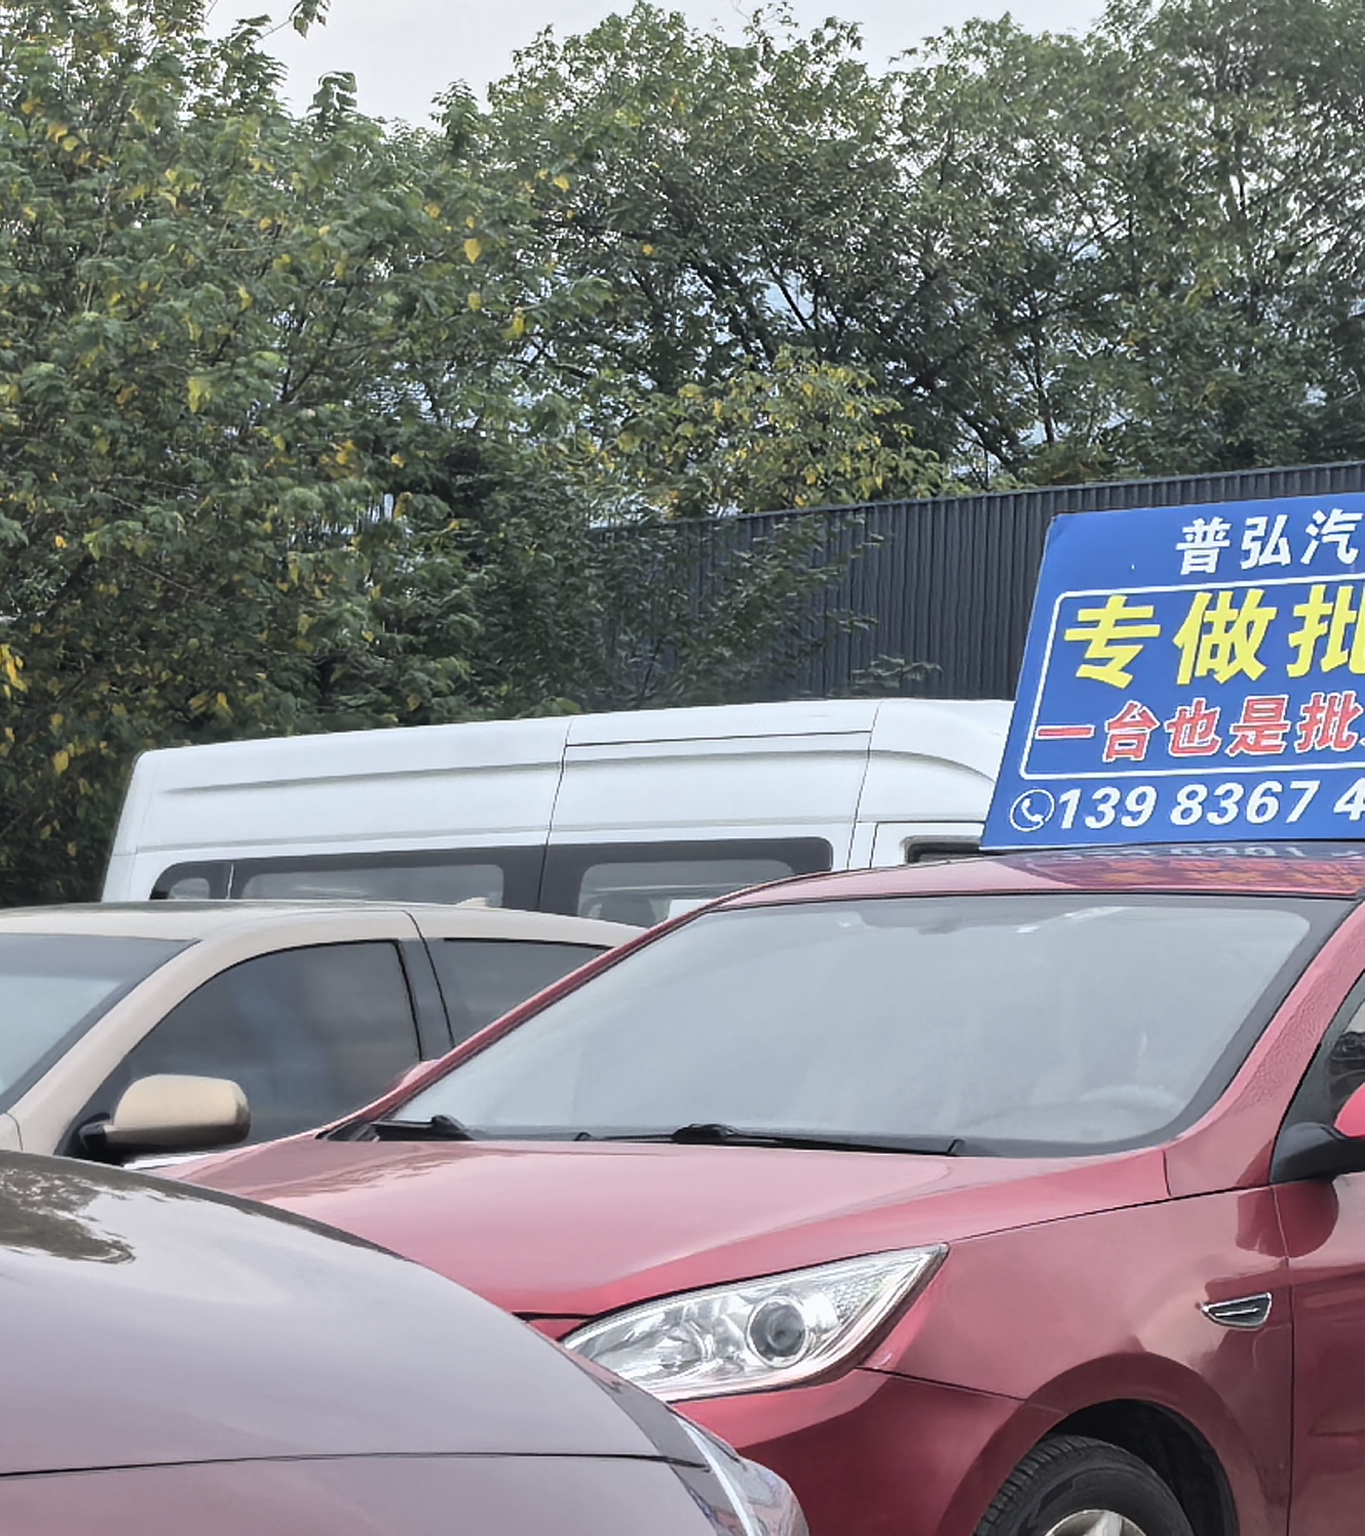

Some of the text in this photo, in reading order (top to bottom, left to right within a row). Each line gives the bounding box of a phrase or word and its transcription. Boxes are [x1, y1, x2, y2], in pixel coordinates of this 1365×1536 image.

[1176, 509, 1363, 574] 普弘汽
[1036, 692, 1365, 762] 一台也是批
[1058, 786, 1157, 829] 139
[1171, 781, 1321, 825] 8367
